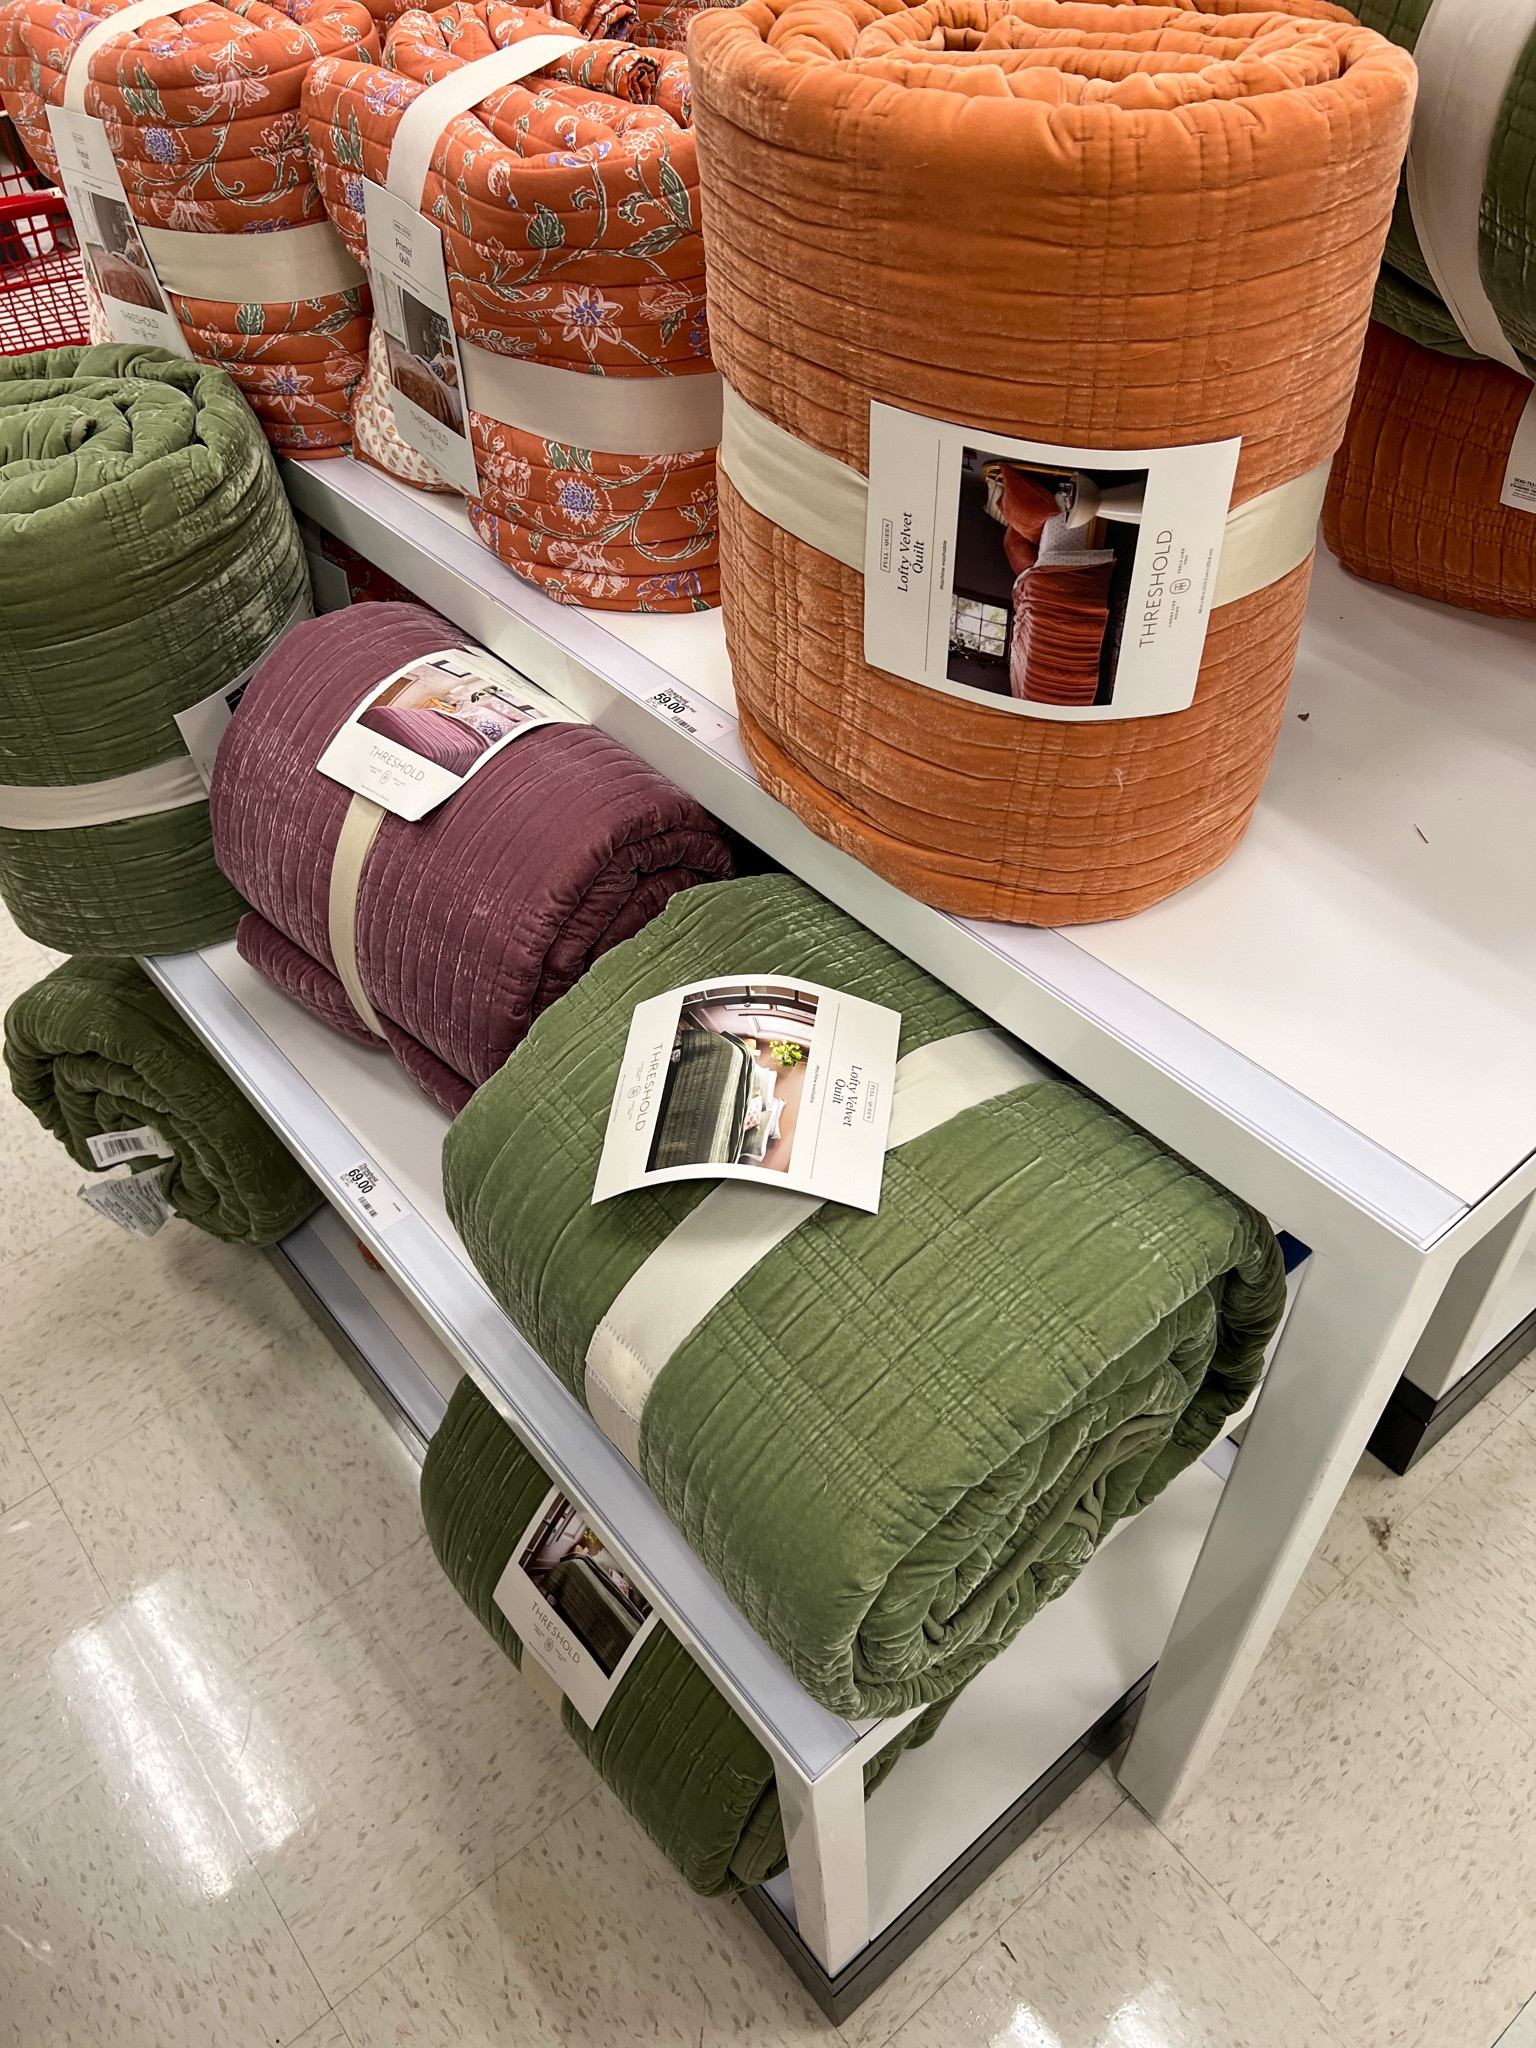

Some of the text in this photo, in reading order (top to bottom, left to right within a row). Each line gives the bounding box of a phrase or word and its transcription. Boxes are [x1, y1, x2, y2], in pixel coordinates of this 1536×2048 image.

[897, 511, 912, 592] Lofty Velvet
[911, 539, 925, 574] Quilt
[1139, 529, 1173, 648] THRESHOLD
[653, 692, 685, 714] 59.00
[370, 745, 425, 781] THRESHOLD
[635, 1042, 664, 1132] THRESHOLD
[832, 1078, 847, 1104] Quilt
[842, 1065, 862, 1127] Lofty Velvet
[348, 1168, 374, 1194] 69.00
[531, 1600, 580, 1665] THRESHOLD
